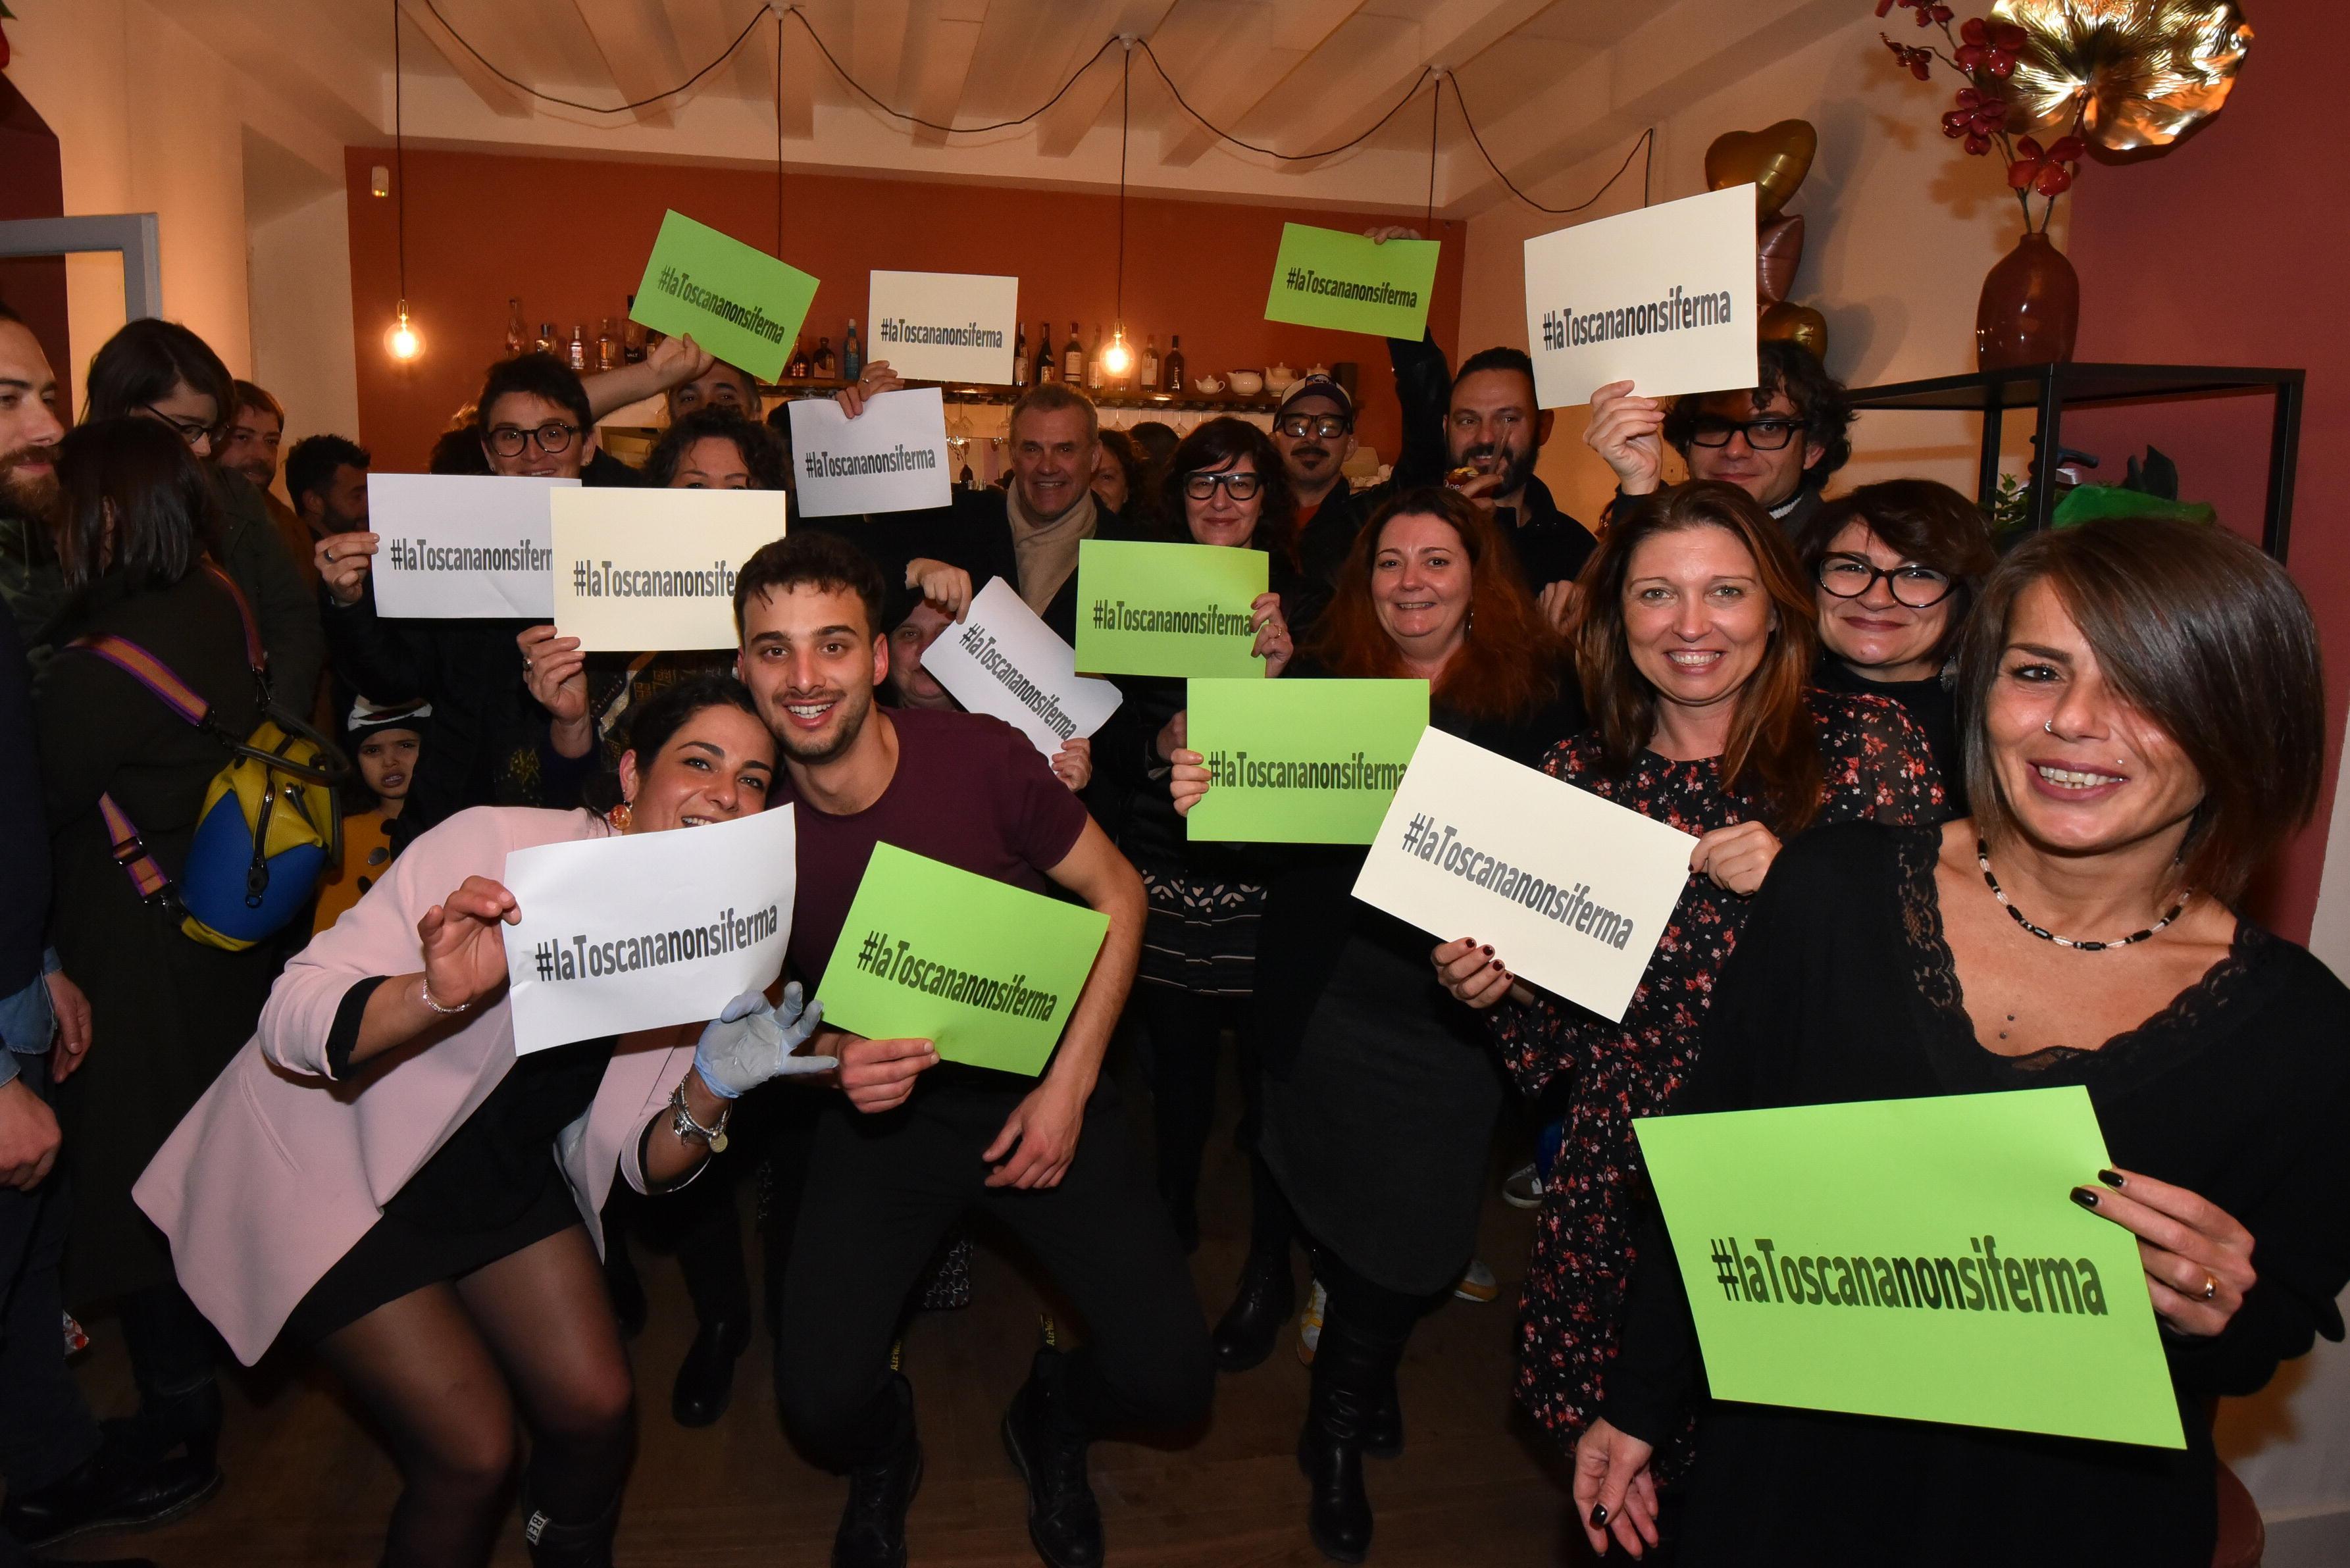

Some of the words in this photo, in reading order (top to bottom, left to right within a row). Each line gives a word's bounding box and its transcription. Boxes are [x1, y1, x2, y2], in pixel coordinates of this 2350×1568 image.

[657, 265, 785, 345] #laToscananonsiferma
[1287, 267, 1417, 307] #laToscananonsiferma
[1543, 286, 1730, 351] #laToscananonsiferma
[881, 318, 1002, 348] #laToscananonsiferma
[805, 444, 935, 478] #laToscananonsiferma
[390, 538, 553, 571] #laToscananonsifer
[573, 559, 739, 597] #laToscananonsife
[1093, 599, 1252, 636] #laToscananonsiferma
[959, 623, 1077, 740] #laToscananonsiferma
[1402, 812, 1633, 950] #laToscananonsiferma
[535, 905, 777, 982] #laToscananonsiferma
[856, 930, 1058, 1022] #laToscananonsiferma
[1712, 1234, 2108, 1316] #laToscananonsiferma
